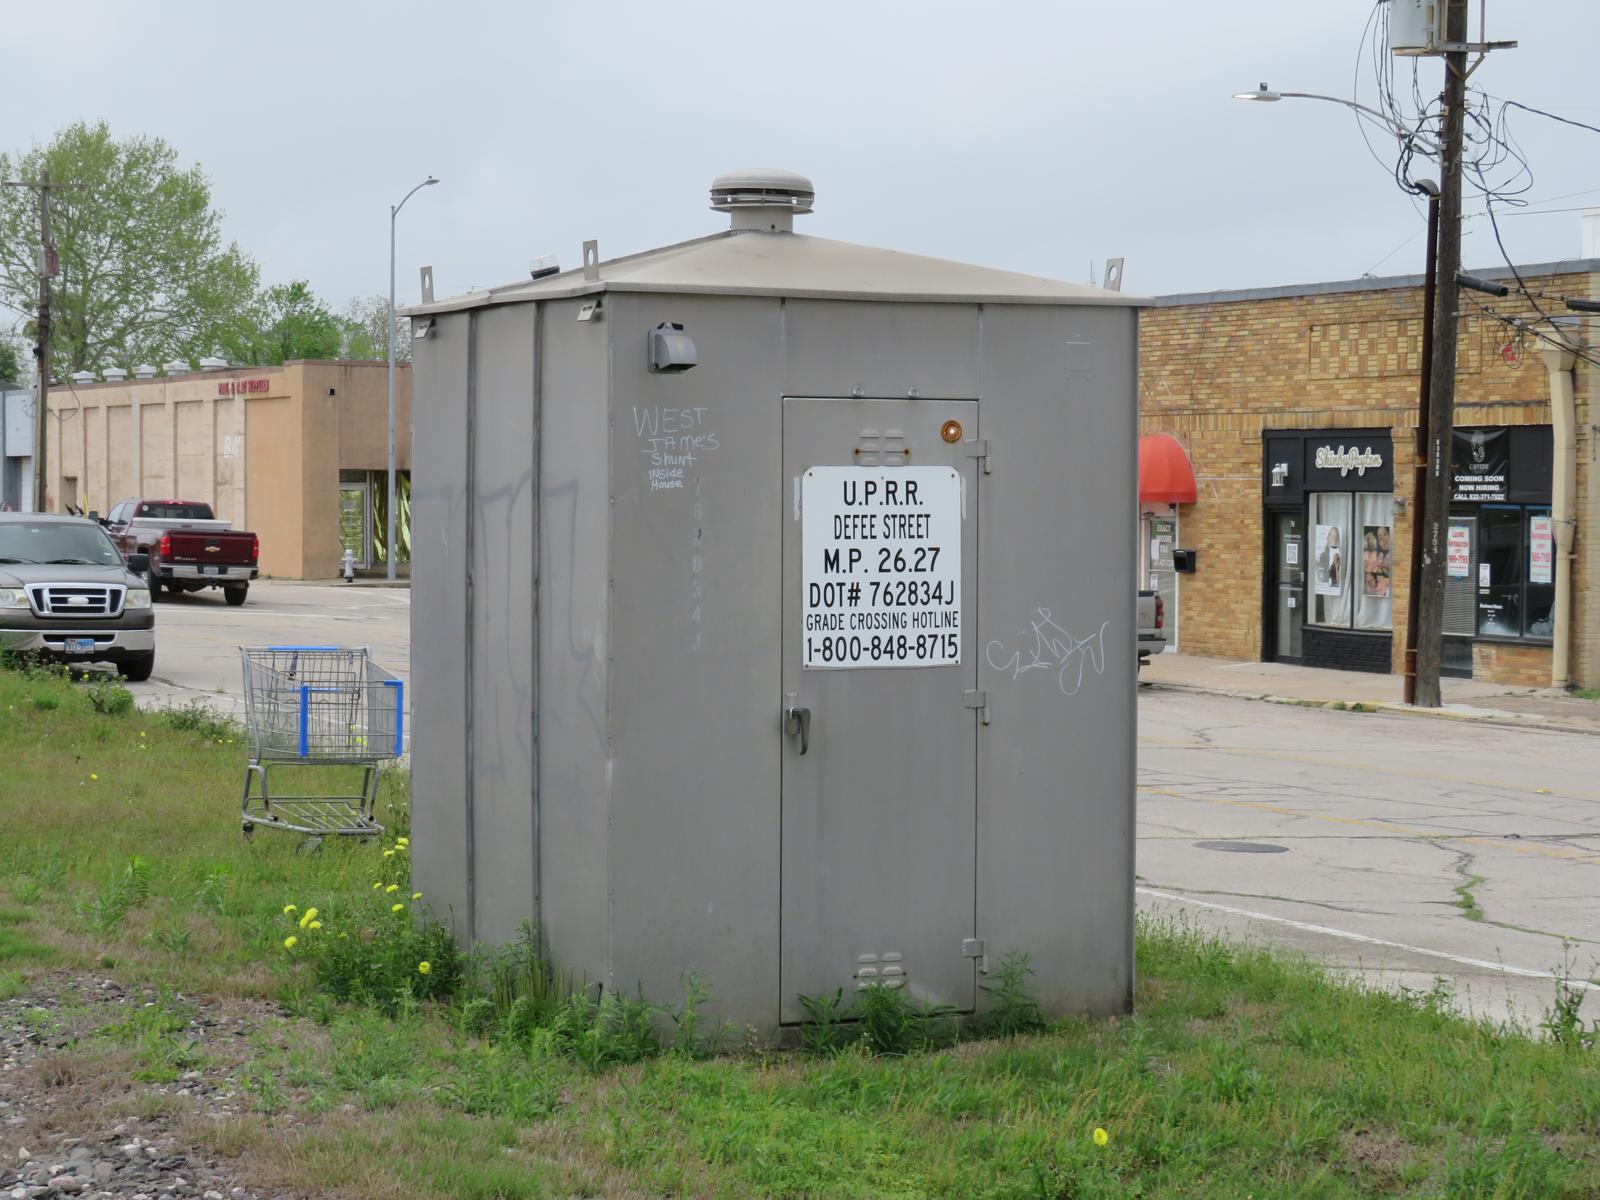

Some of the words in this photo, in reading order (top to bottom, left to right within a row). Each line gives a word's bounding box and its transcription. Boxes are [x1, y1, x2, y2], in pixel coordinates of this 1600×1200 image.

[633, 405, 707, 437] WEST
[844, 480, 924, 506] U.P.R.R.
[834, 514, 877, 540] DEFEE
[882, 513, 931, 539] STREET
[824, 548, 869, 574] M.P.
[878, 547, 941, 573] 26.27
[809, 582, 862, 608] DOT#
[869, 580, 954, 606] 762834J
[806, 613, 845, 631] GRADE
[850, 612, 908, 630] CROSSING
[912, 610, 959, 629] HOTLINE
[807, 633, 959, 662] 1-800-848-8715
